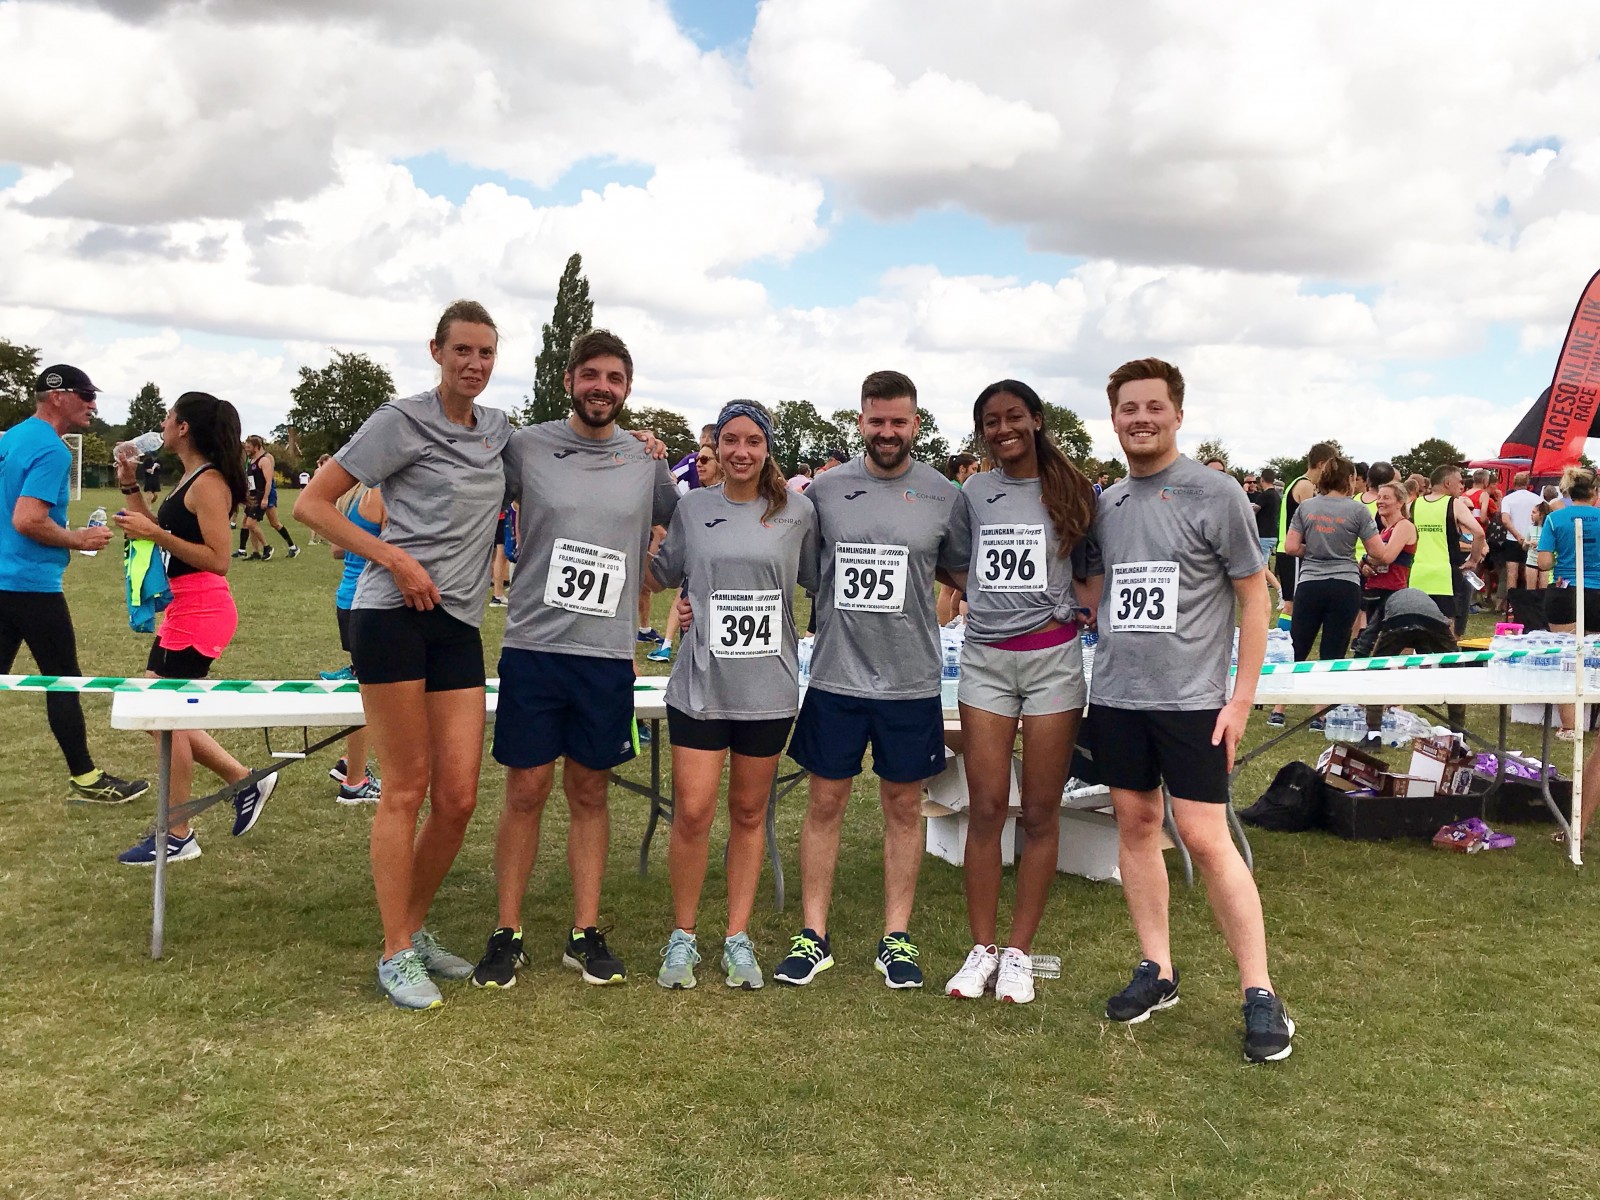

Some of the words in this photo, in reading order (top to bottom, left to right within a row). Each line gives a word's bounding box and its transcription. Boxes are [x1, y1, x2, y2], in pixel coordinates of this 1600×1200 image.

[1574, 387, 1597, 422] RACE
[773, 518, 802, 526] CONRAD
[558, 554, 596, 567] FRAMLINGHAM
[840, 557, 876, 566] FRAMLINGHAM
[985, 549, 1035, 580] 396
[557, 566, 609, 604] 391
[843, 567, 894, 600] 395
[1117, 587, 1164, 620] 393
[720, 615, 771, 647] 394
